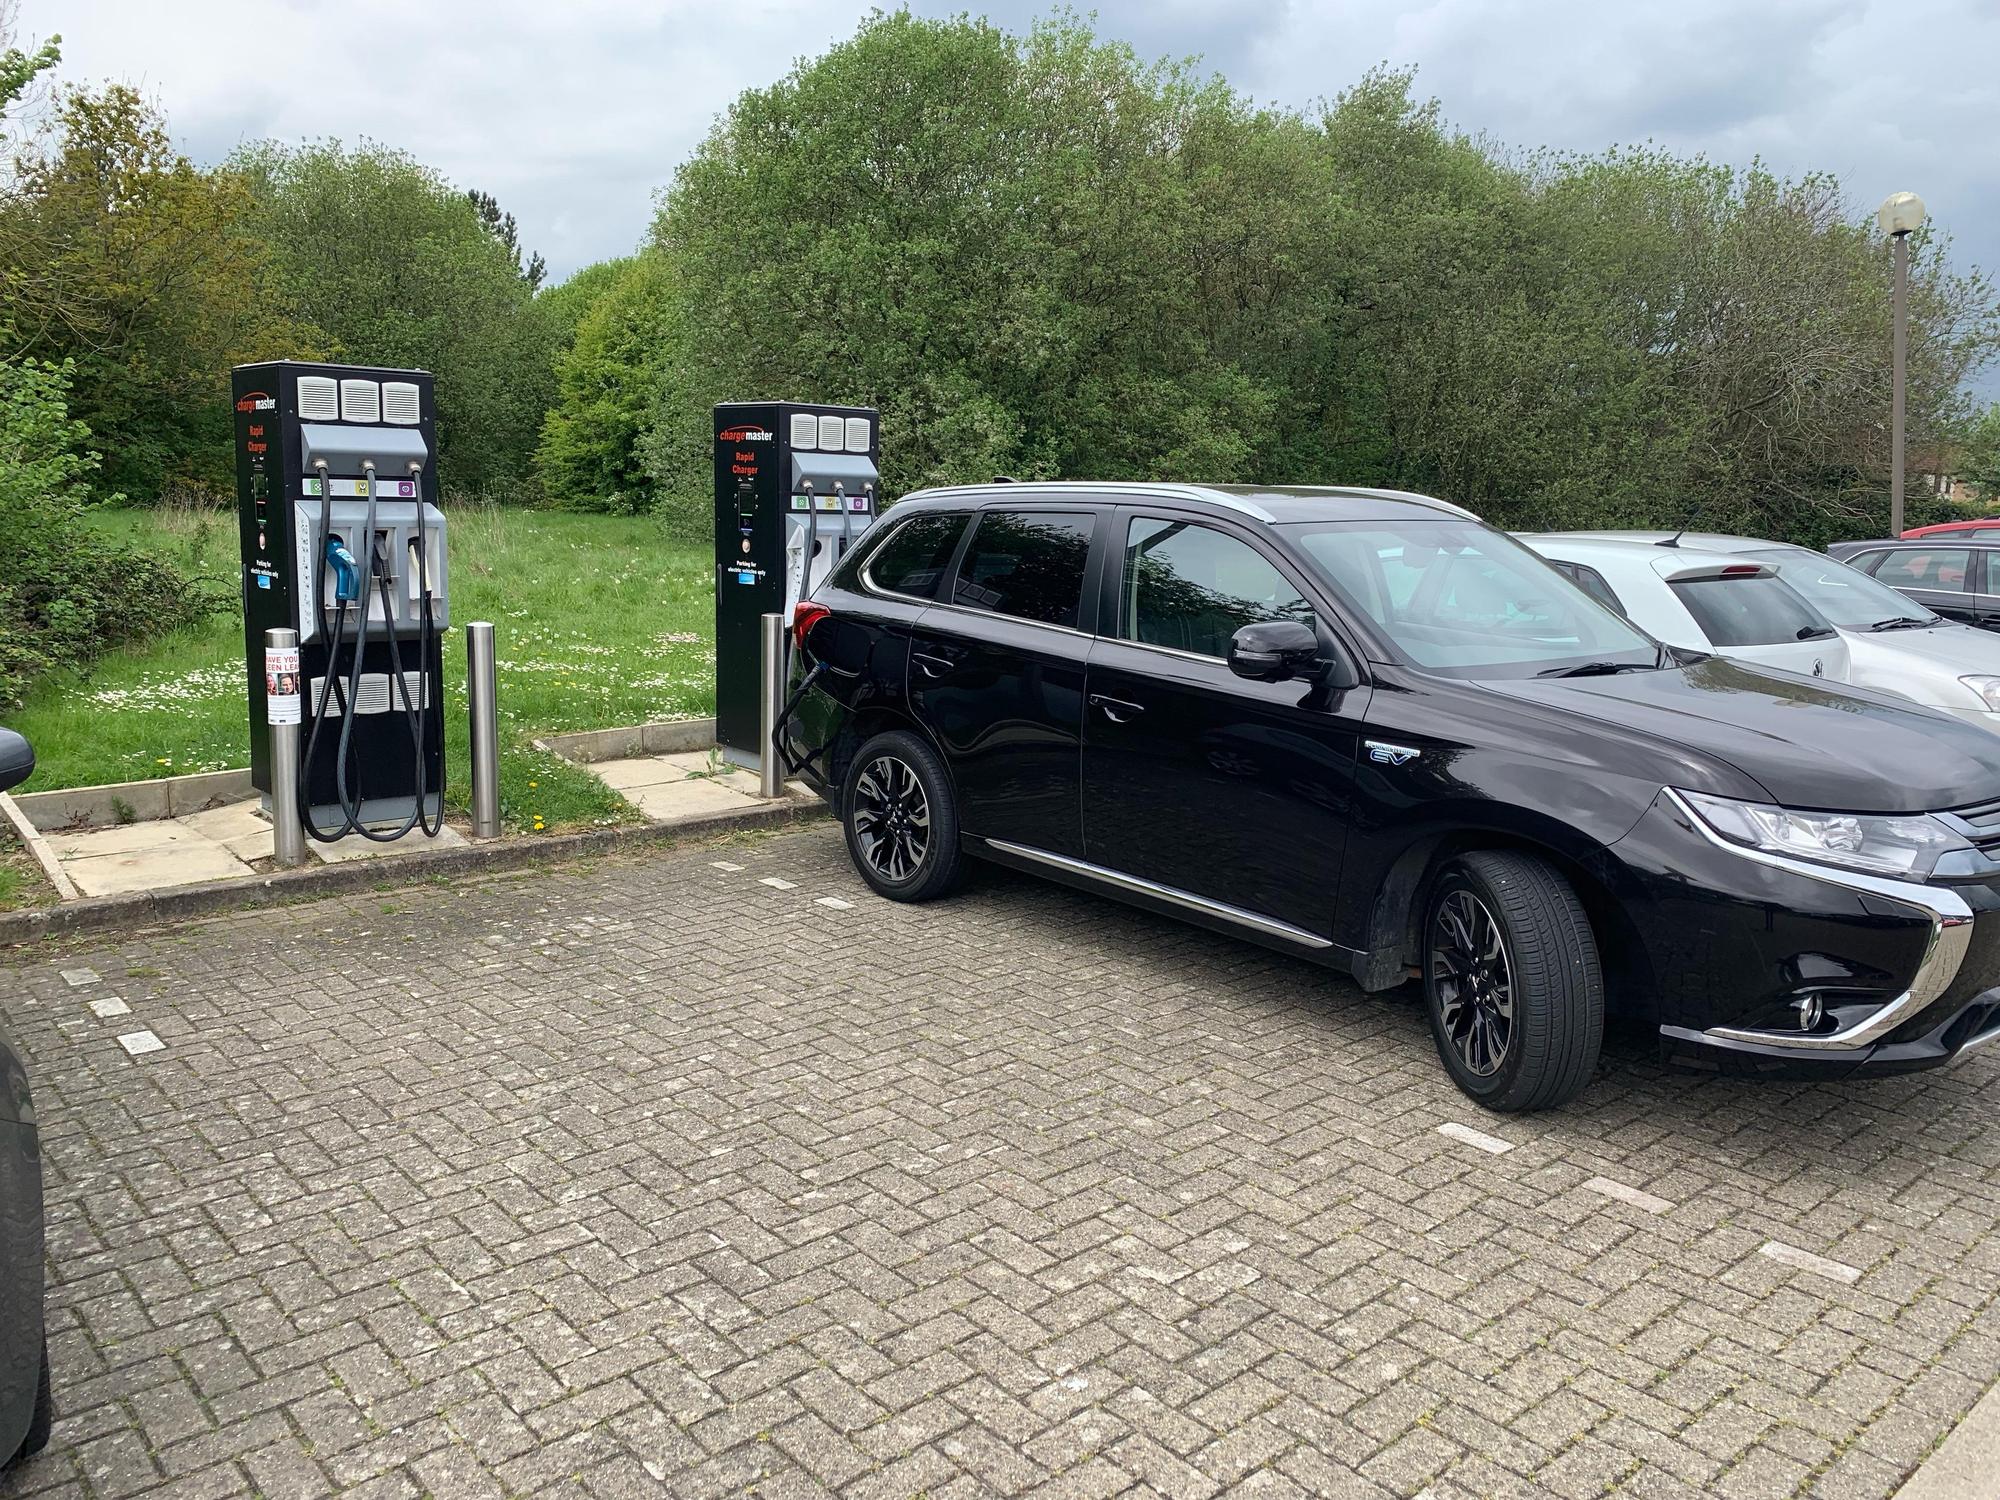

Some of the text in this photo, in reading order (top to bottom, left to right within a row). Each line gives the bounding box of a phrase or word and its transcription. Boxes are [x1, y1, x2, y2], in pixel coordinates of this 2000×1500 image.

[238, 396, 276, 414] chargemaster
[249, 425, 264, 438] Rapid
[720, 429, 773, 443] chargemaster
[248, 441, 267, 454] Charger
[735, 452, 755, 463] Rapid
[732, 464, 759, 476] Charger
[283, 655, 298, 664] YOU
[284, 663, 299, 671] LEA
